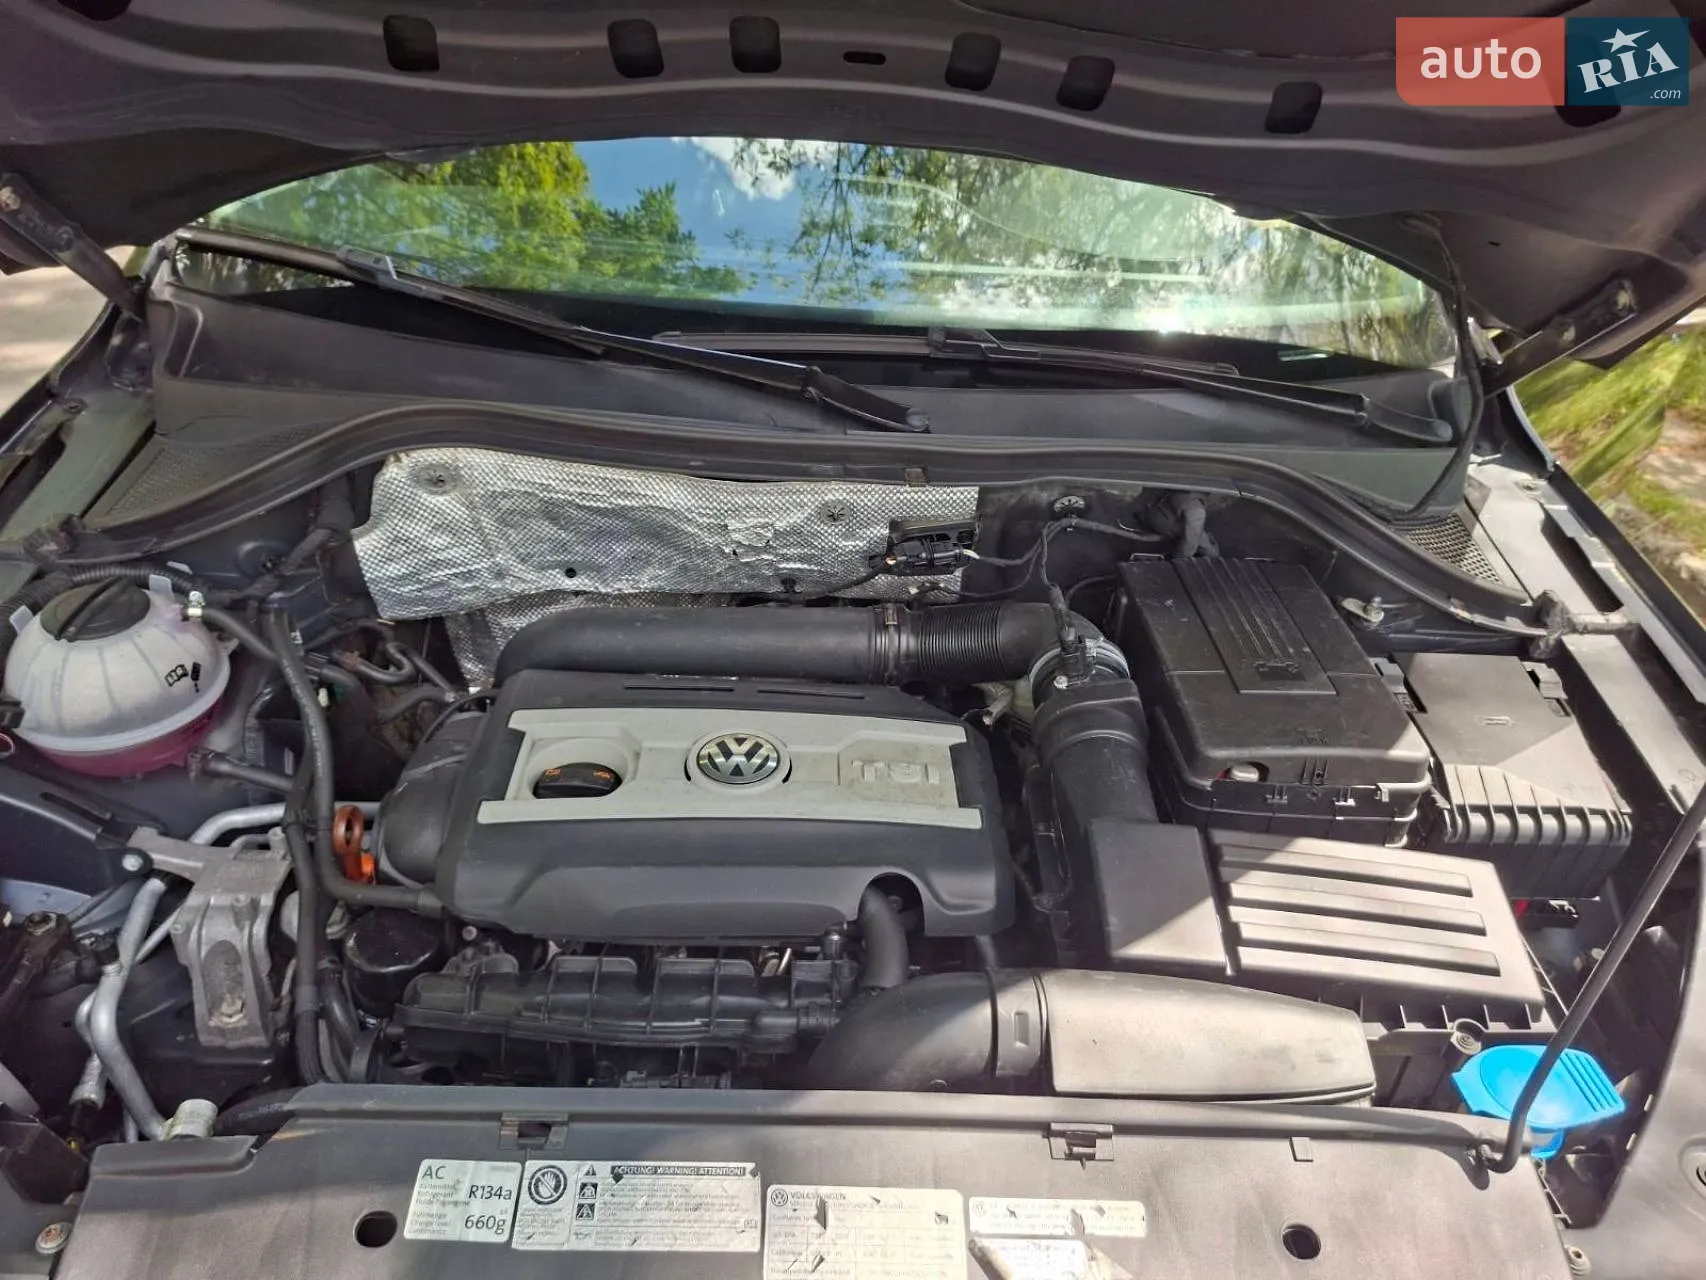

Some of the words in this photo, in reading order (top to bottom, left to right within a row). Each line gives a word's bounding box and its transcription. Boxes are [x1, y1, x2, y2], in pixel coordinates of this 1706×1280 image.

[422, 1165, 447, 1180] AC
[657, 1167, 697, 1175] WARNING!
[699, 1167, 744, 1176] ATTENTION!
[468, 1184, 512, 1200] R134a
[464, 1214, 506, 1235] 660g
